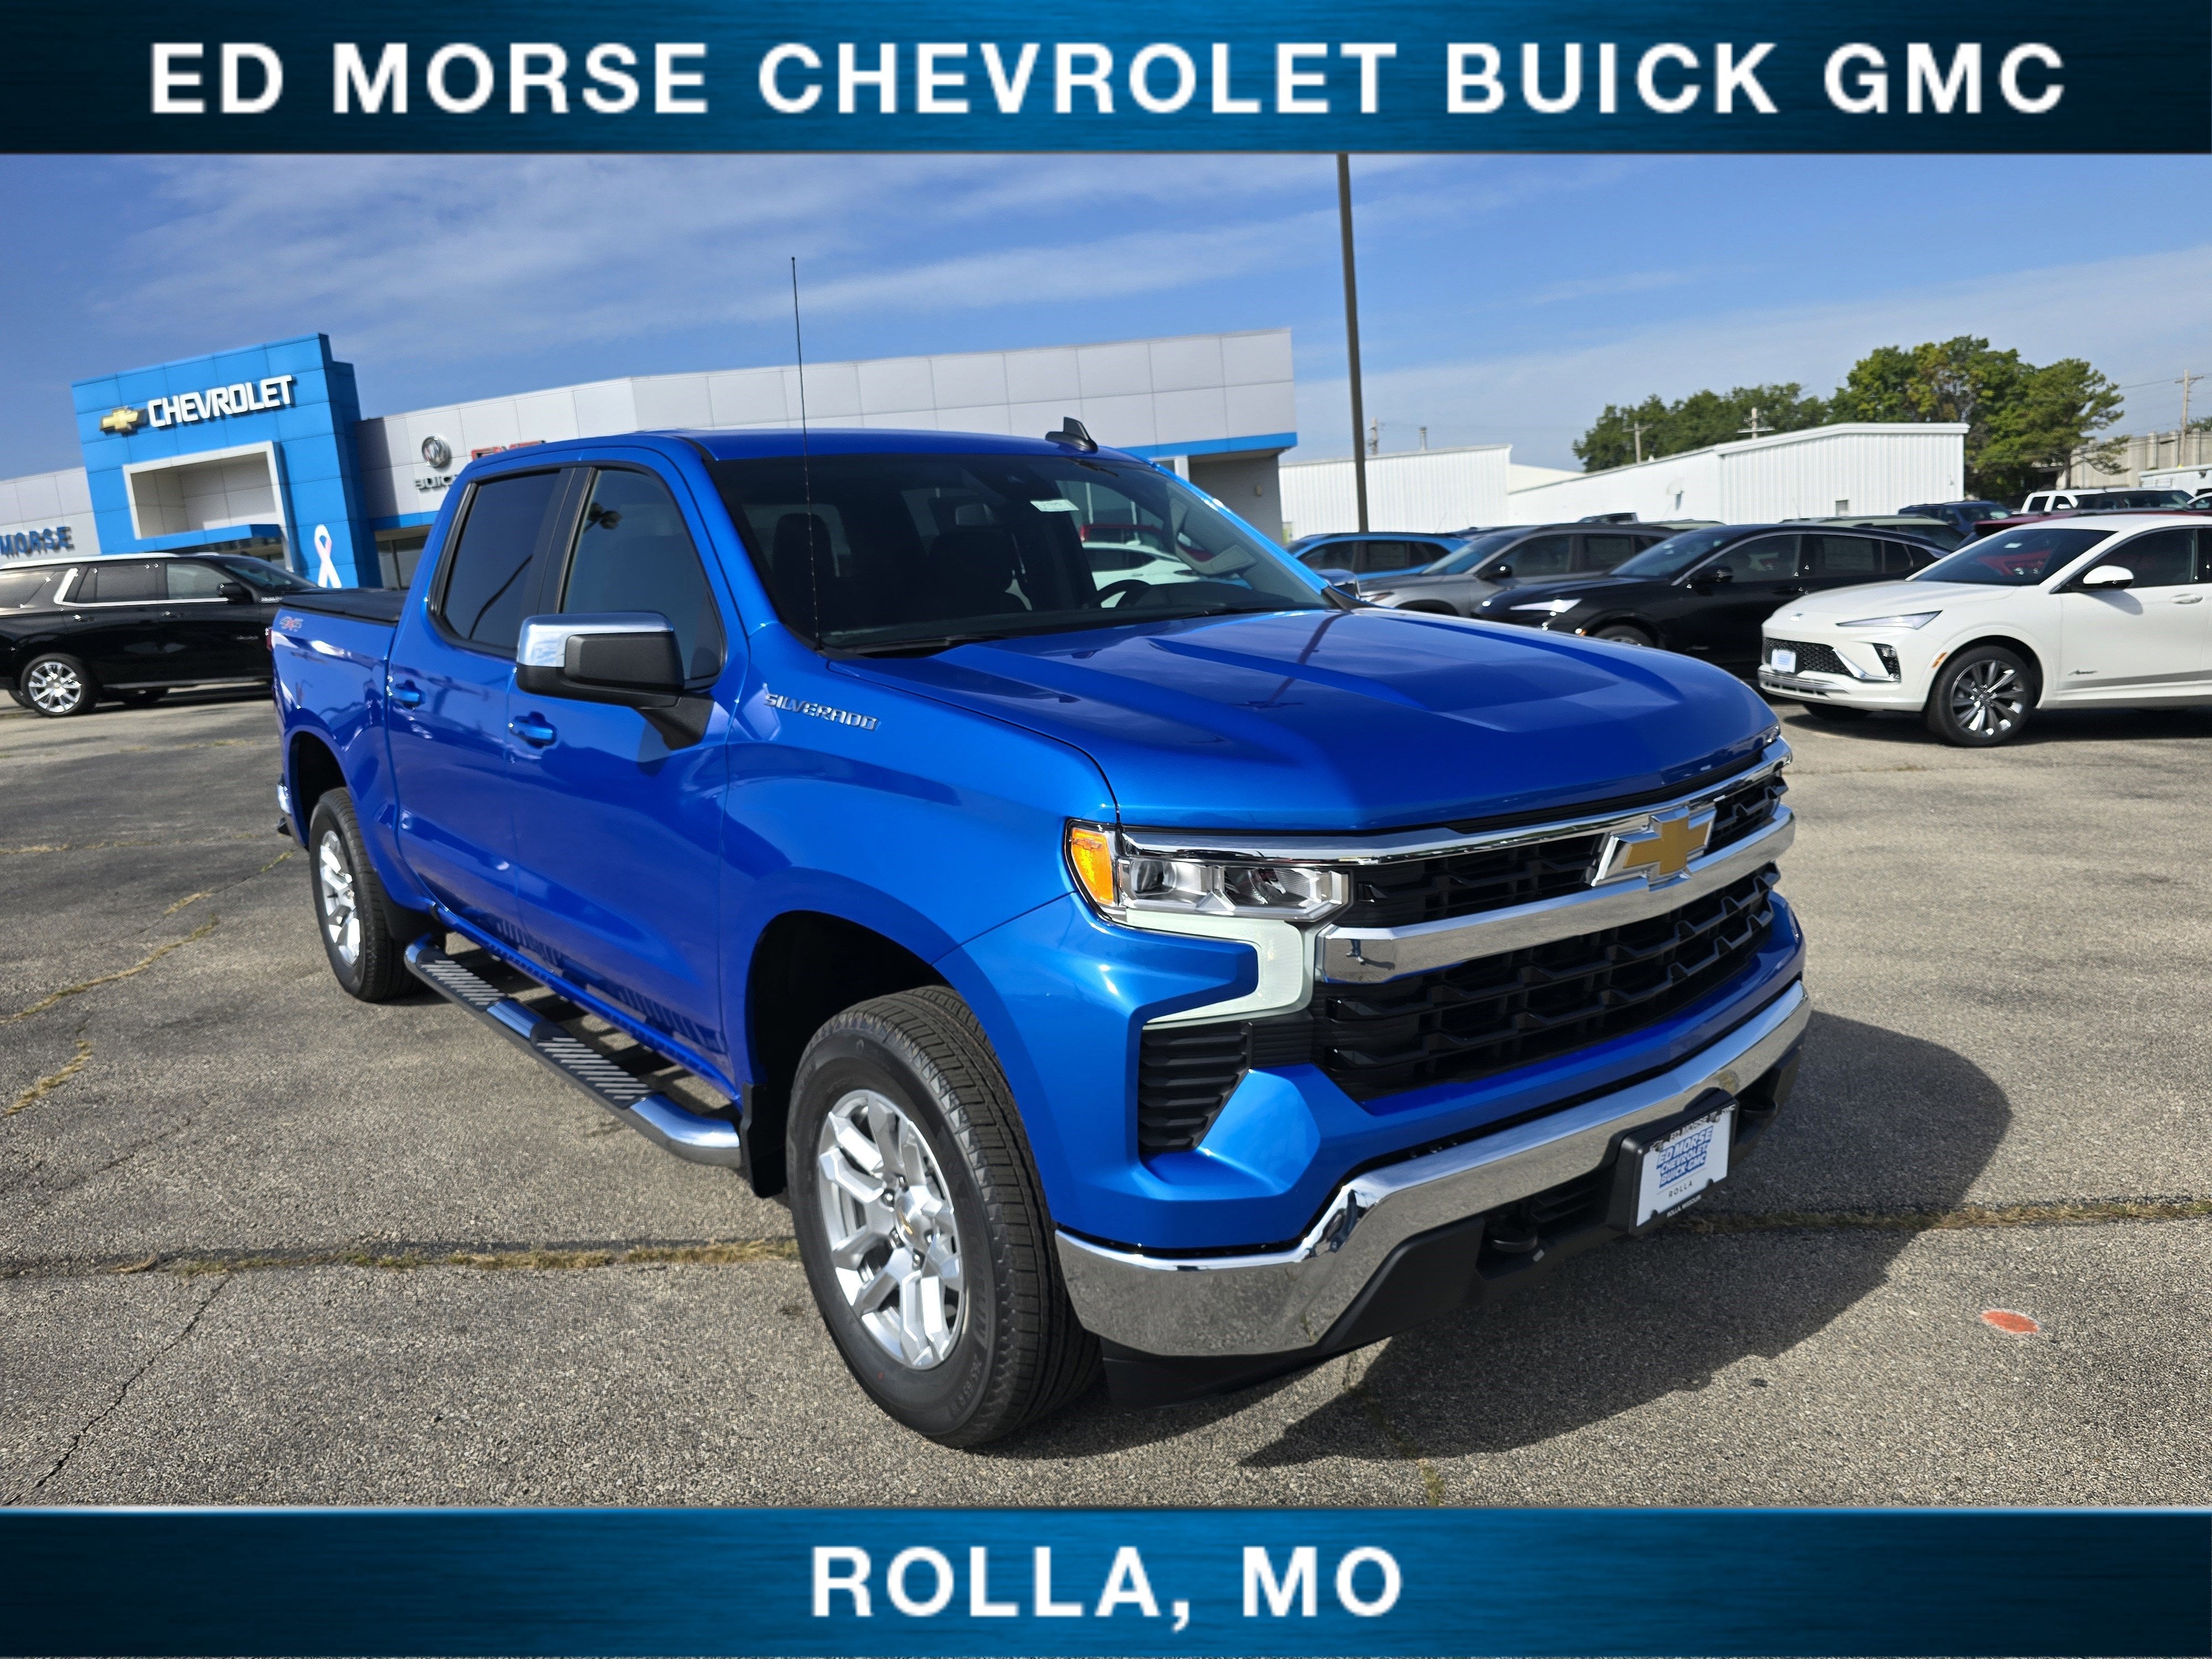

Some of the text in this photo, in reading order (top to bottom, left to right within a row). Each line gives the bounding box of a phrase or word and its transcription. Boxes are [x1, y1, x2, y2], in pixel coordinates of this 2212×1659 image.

[148, 374, 293, 427] CHEVROLET
[415, 474, 457, 491] BUIC
[765, 693, 879, 731] SILVERADO
[1660, 1126, 1713, 1163] ED MORSE
[1668, 1180, 1692, 1198] ROLLA
